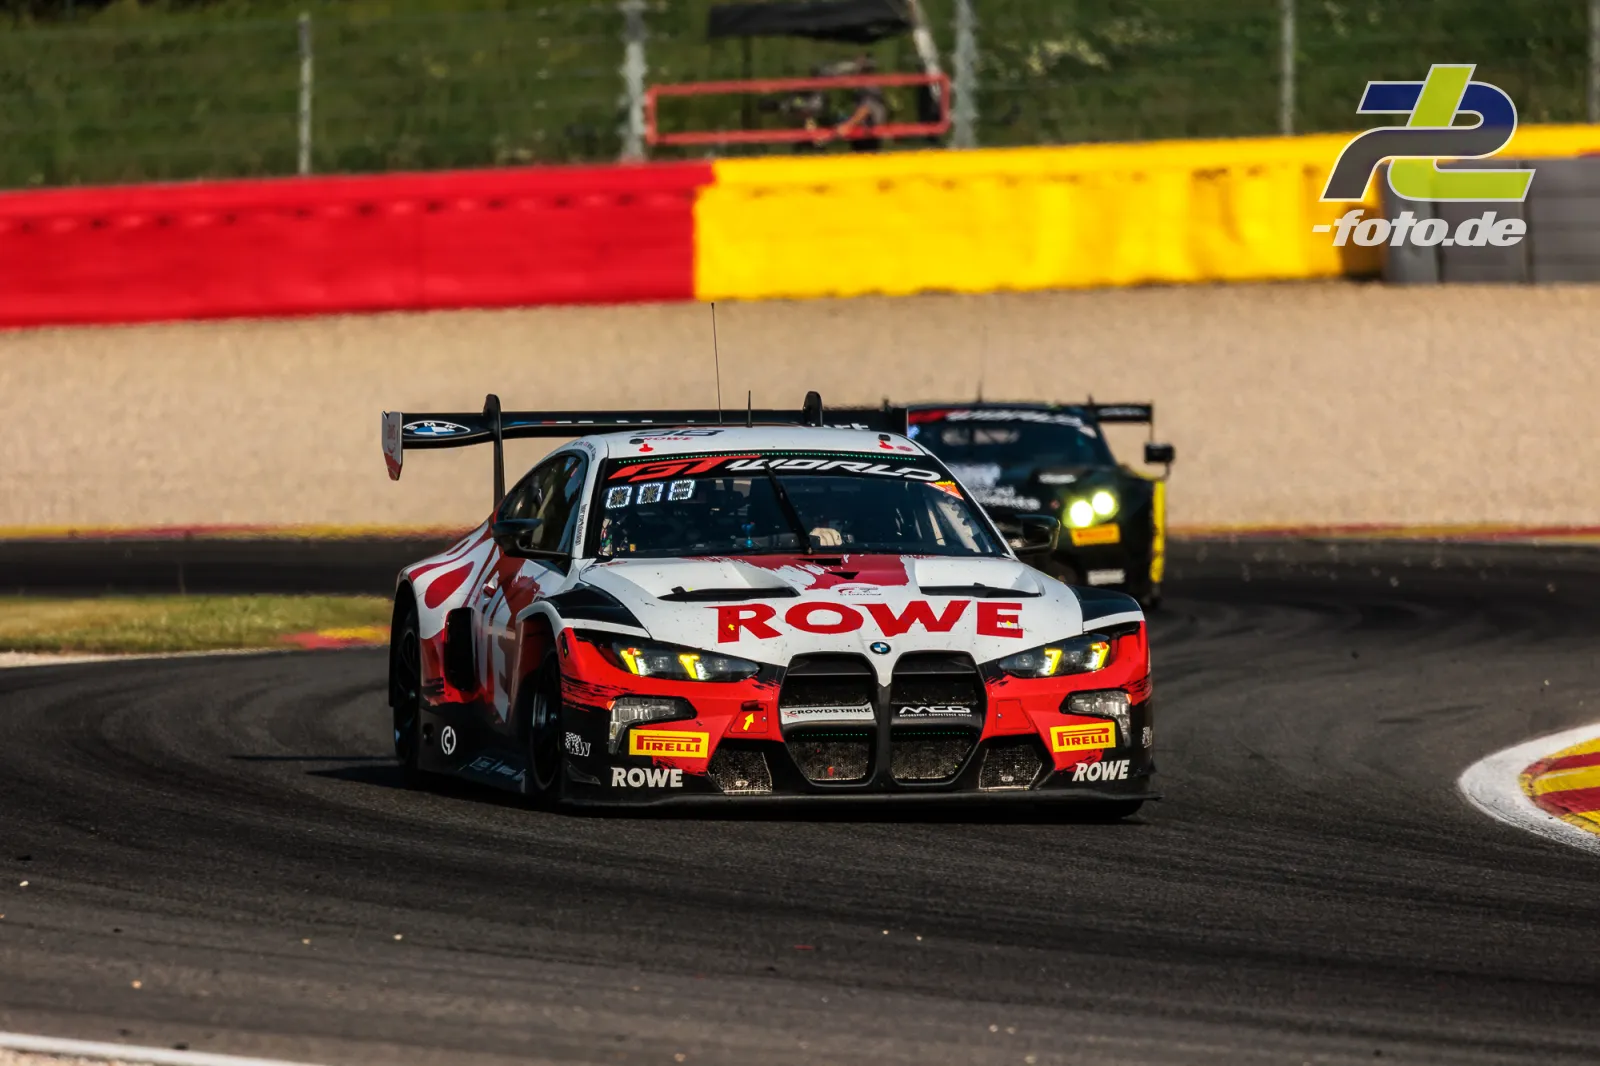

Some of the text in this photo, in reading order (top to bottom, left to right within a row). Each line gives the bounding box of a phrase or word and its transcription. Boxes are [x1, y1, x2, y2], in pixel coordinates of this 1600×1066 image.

[704, 600, 1024, 644] ROWE
[790, 706, 872, 715] CROWDSTRIKE
[637, 734, 702, 753] PIRELLI
[1057, 728, 1110, 746] PIRELLI
[611, 767, 683, 788] ROWE
[1072, 760, 1131, 782] ROWE
